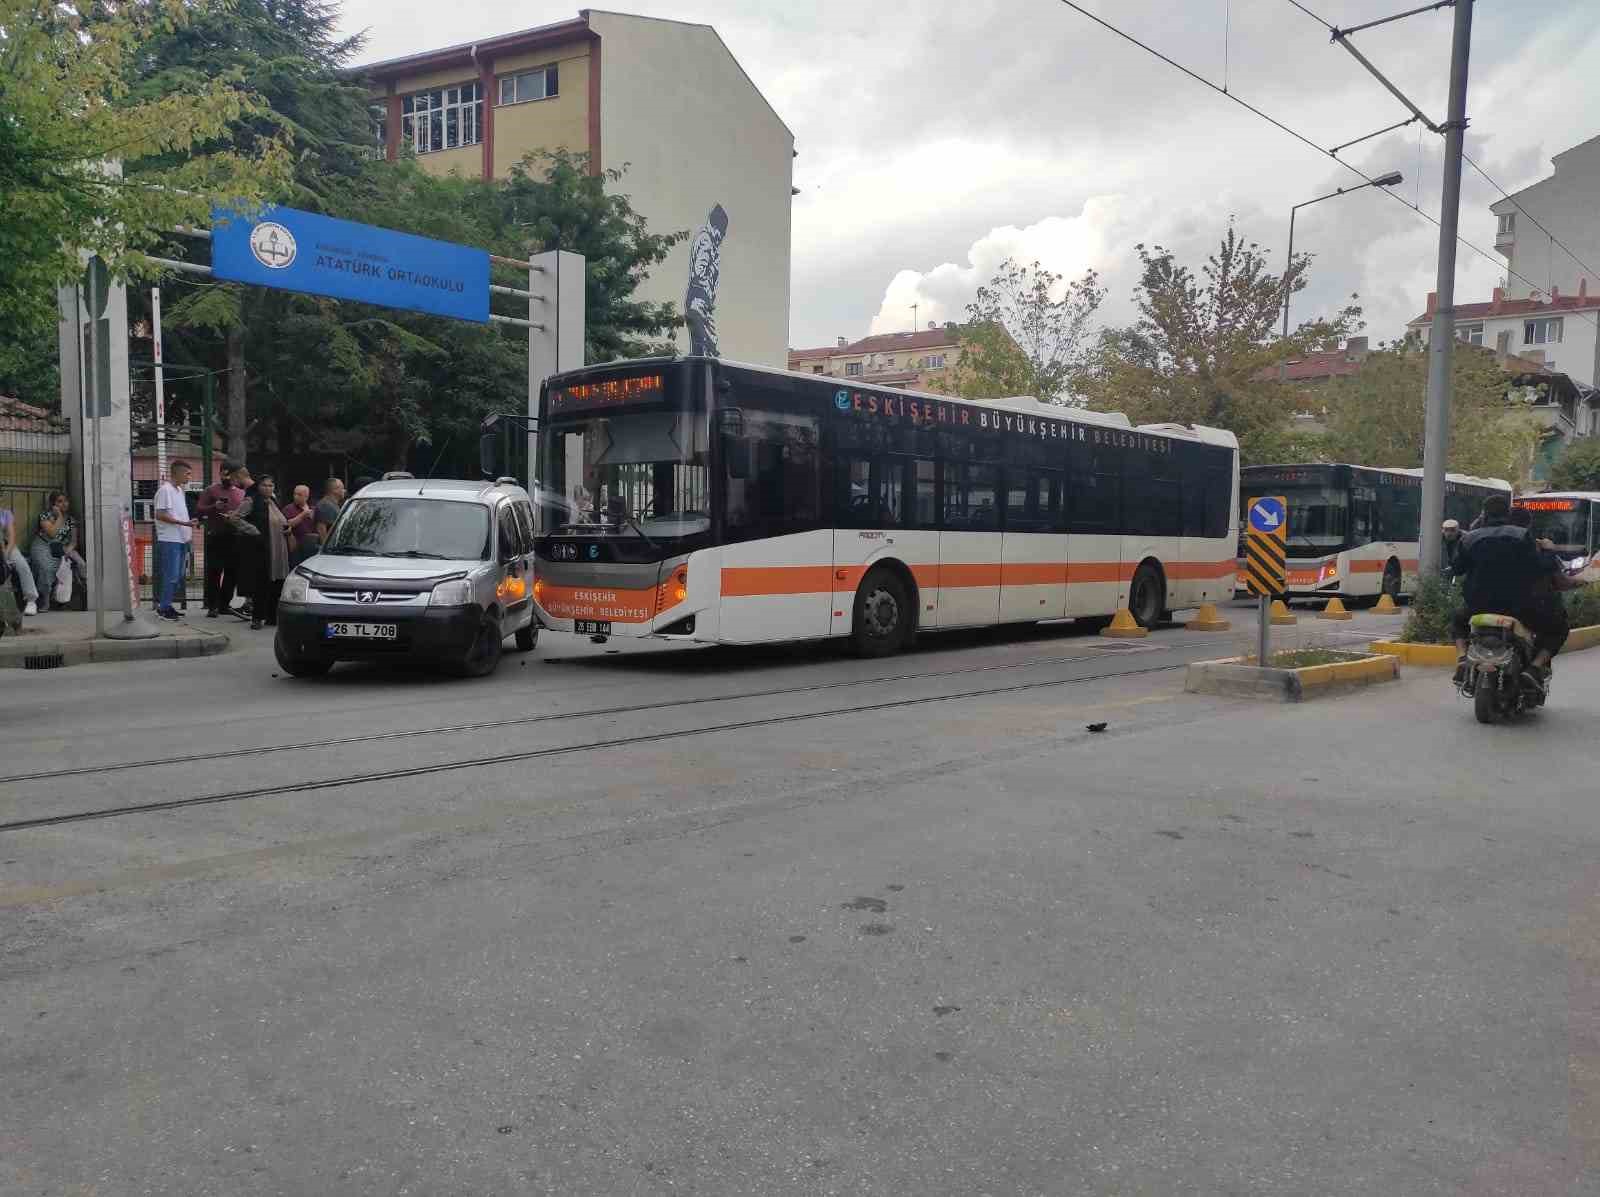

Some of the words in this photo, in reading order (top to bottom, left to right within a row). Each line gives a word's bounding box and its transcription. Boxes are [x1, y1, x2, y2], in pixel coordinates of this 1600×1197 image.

[316, 255, 382, 278] ATATÜRK
[387, 267, 465, 293] ORTAOKULU
[853, 390, 970, 425] ESKİŞEHİR
[980, 411, 1085, 441] BÜYÜKŞEHİR
[1094, 430, 1171, 453] BELEDİYESİ
[334, 623, 348, 634] 26
[354, 624, 371, 635] TL
